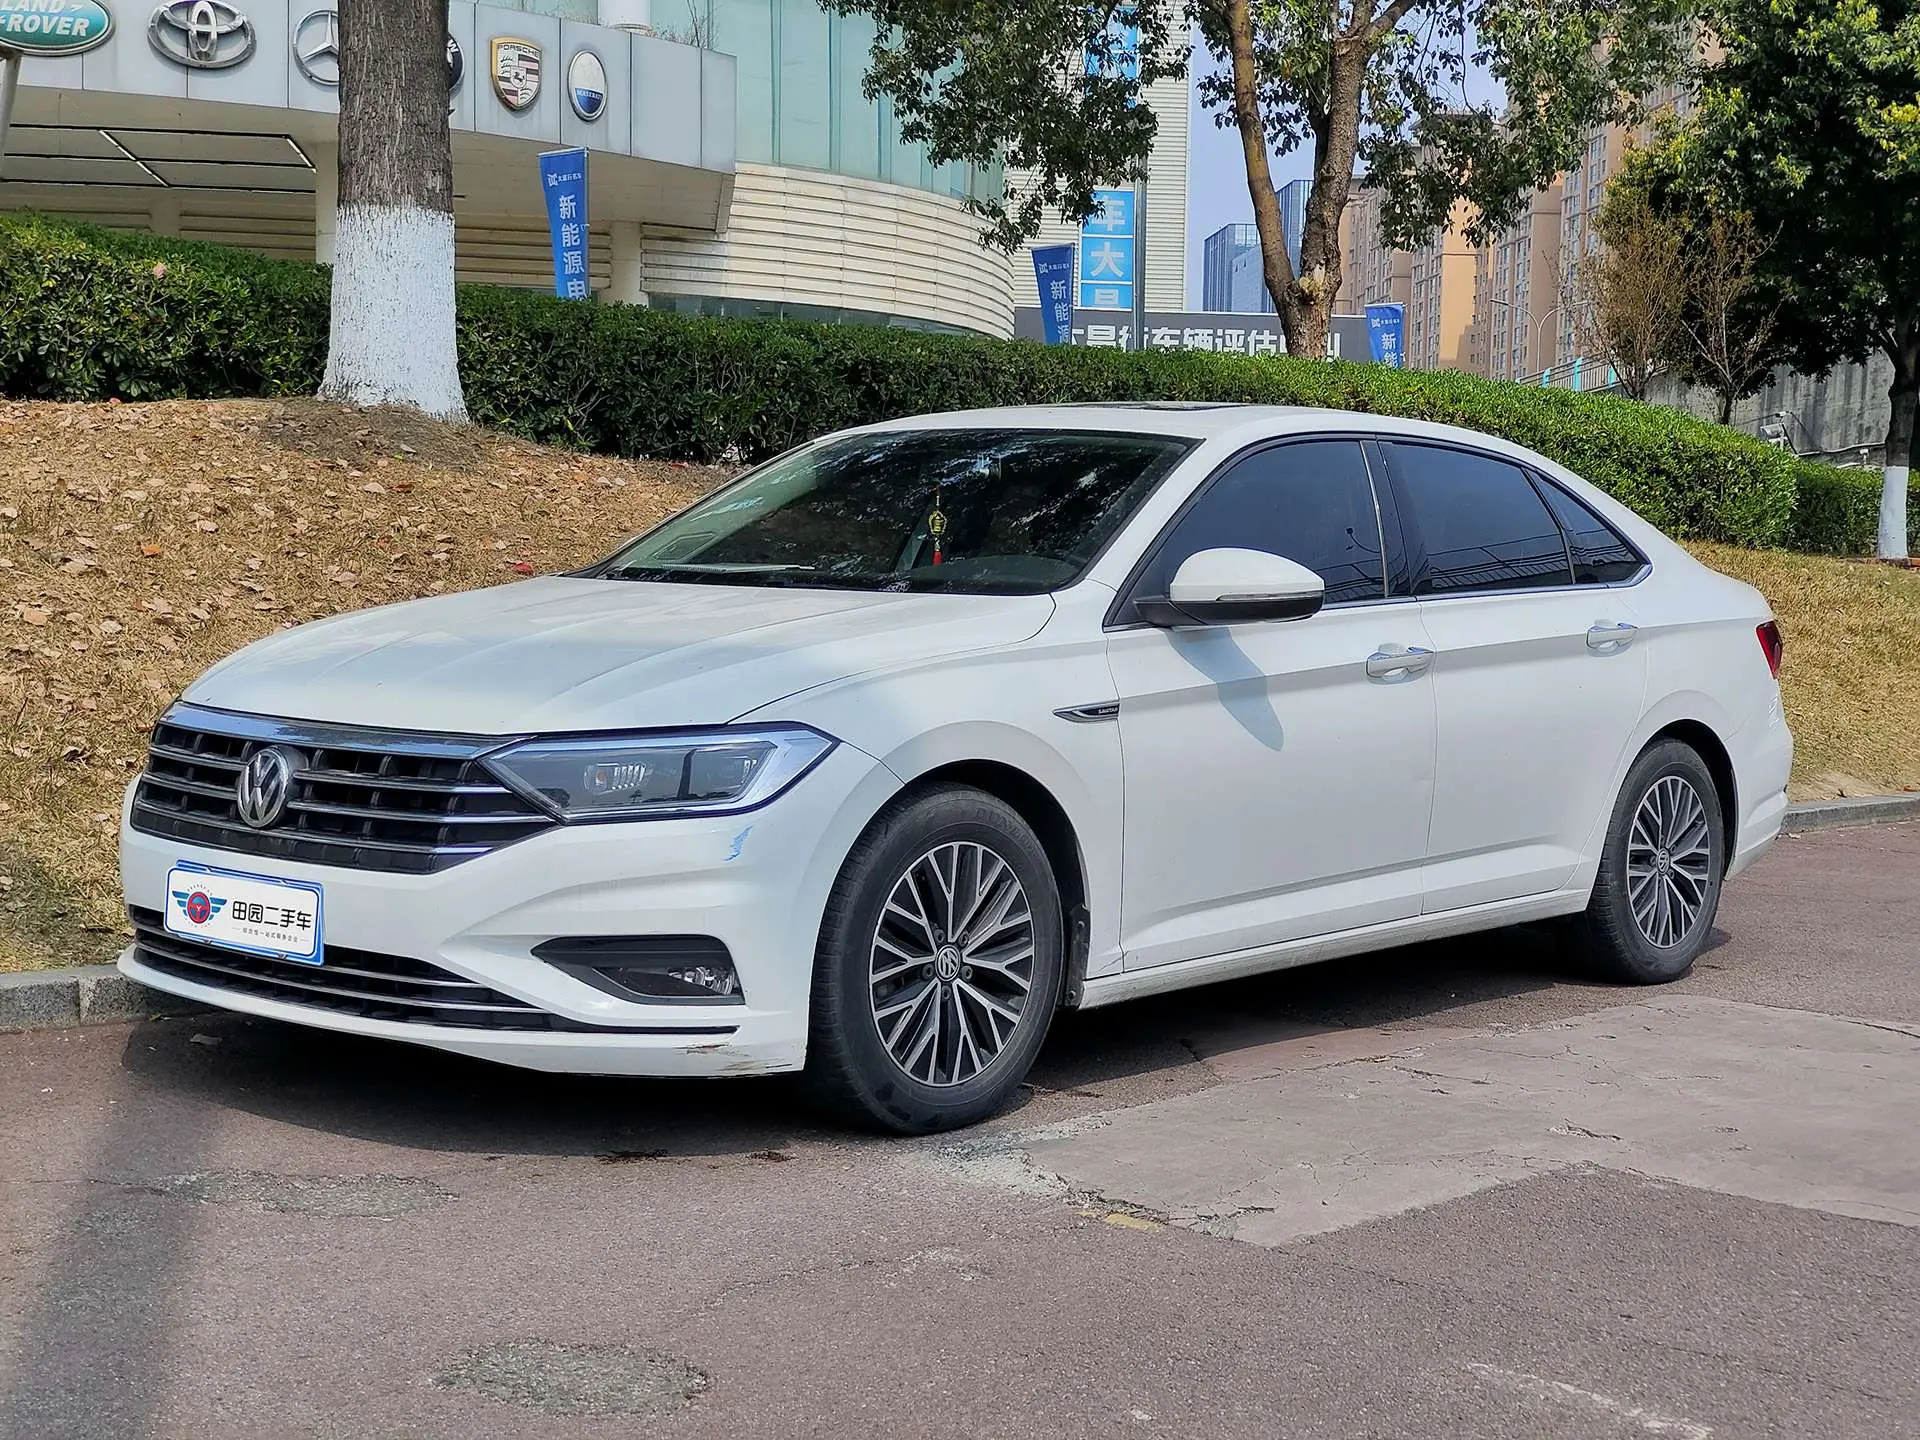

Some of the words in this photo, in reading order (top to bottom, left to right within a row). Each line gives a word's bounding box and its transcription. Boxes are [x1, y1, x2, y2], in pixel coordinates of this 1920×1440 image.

[6, 13, 90, 36] ROVER
[497, 44, 541, 58] PORSCHE
[232, 900, 312, 931] 田园二手车
